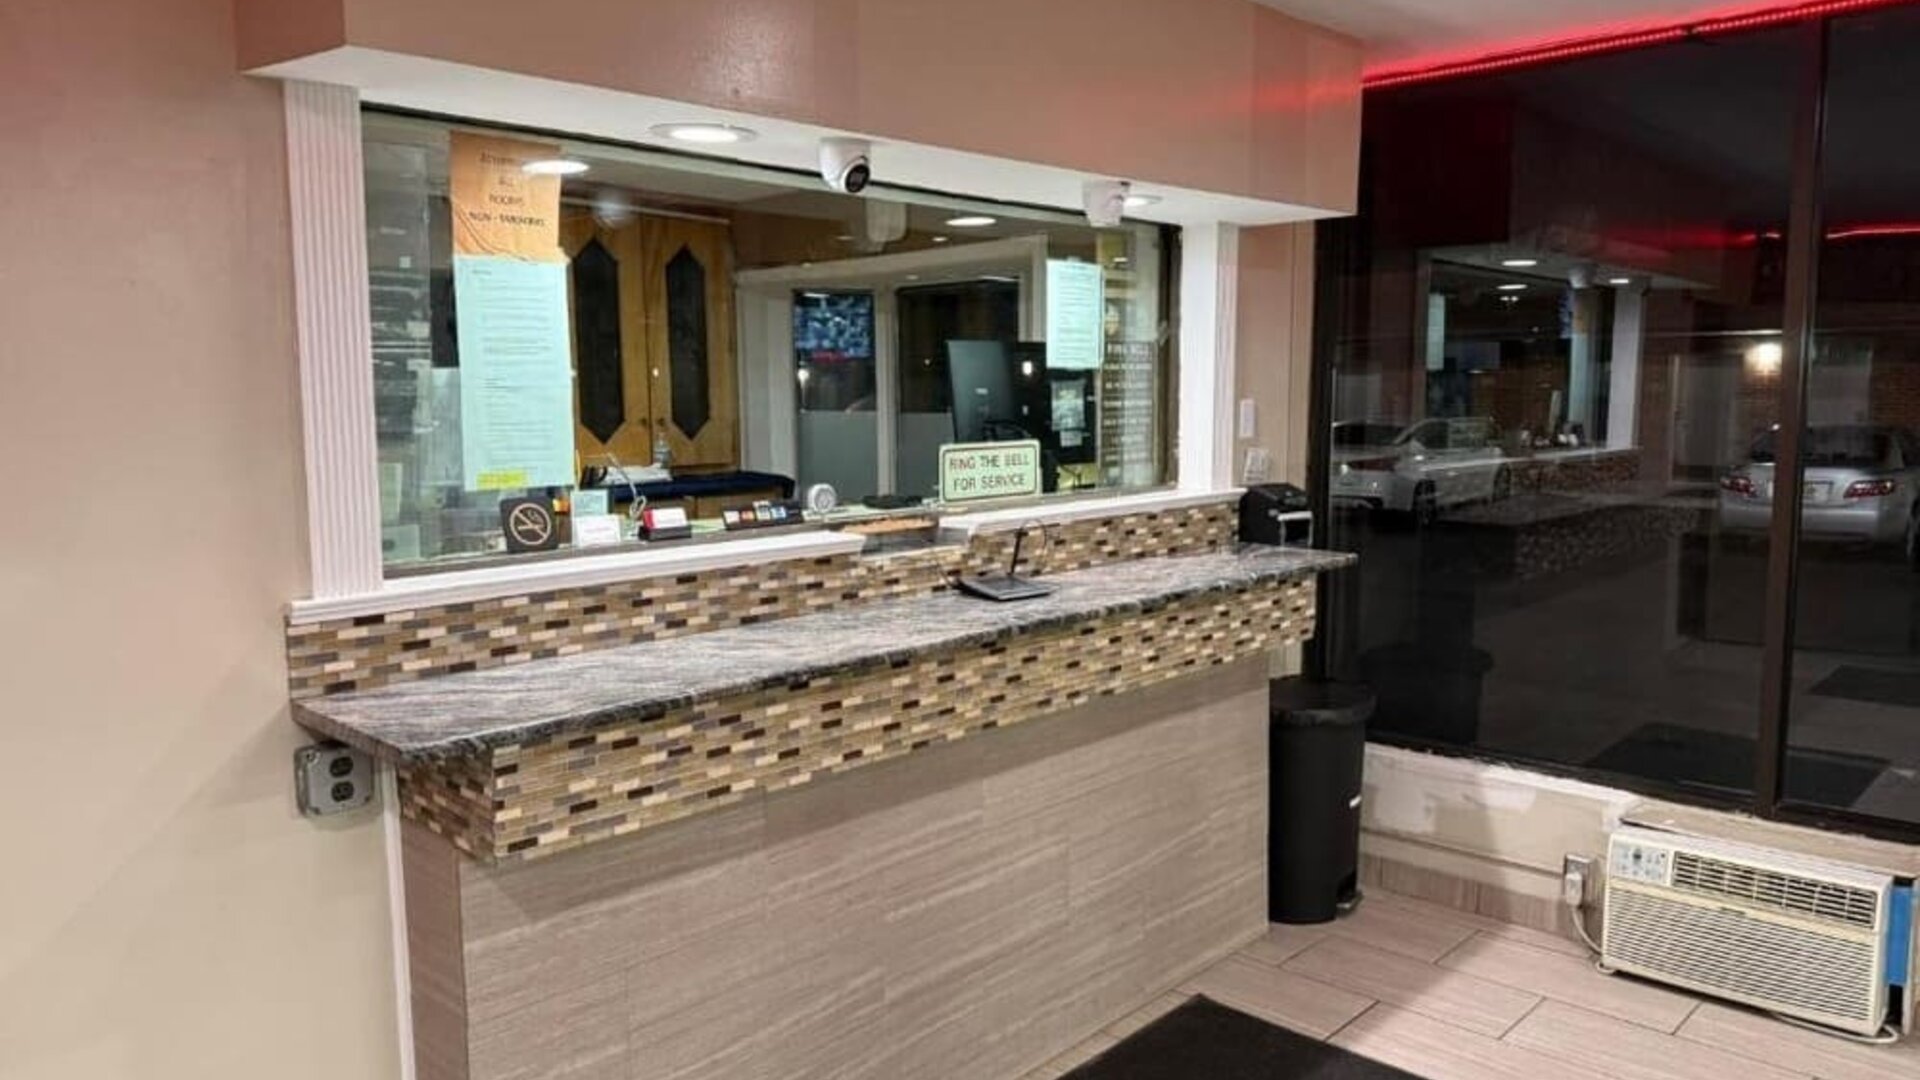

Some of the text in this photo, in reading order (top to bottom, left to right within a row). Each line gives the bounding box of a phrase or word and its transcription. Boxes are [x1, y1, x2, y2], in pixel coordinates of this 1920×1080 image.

[950, 453, 1030, 470] RING THE BELL
[953, 473, 1025, 492] FOR SERVICE
